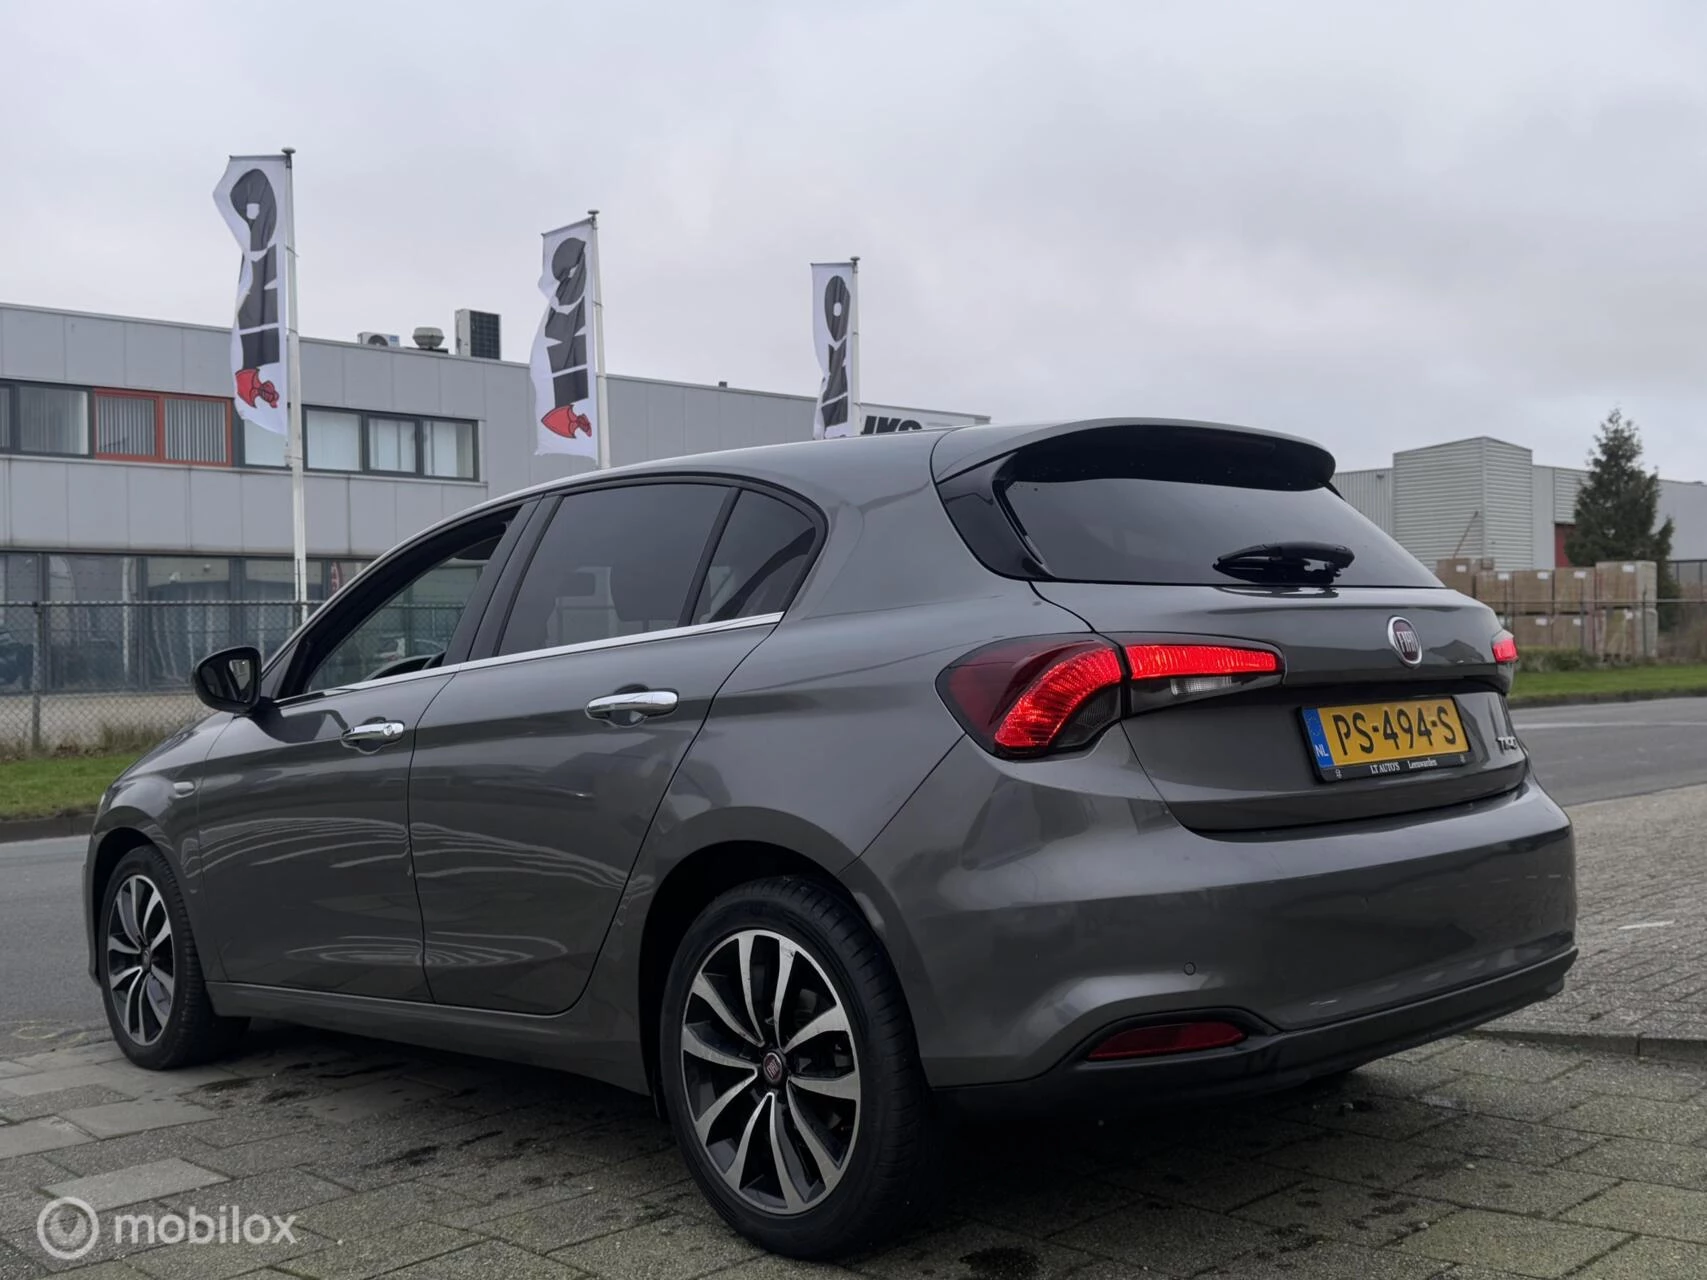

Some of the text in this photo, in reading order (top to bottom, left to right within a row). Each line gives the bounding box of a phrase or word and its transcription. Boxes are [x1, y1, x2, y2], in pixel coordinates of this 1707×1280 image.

[1396, 631, 1419, 653] FIAT
[1332, 706, 1456, 756] PS-494-S
[1315, 744, 1330, 757] NL
